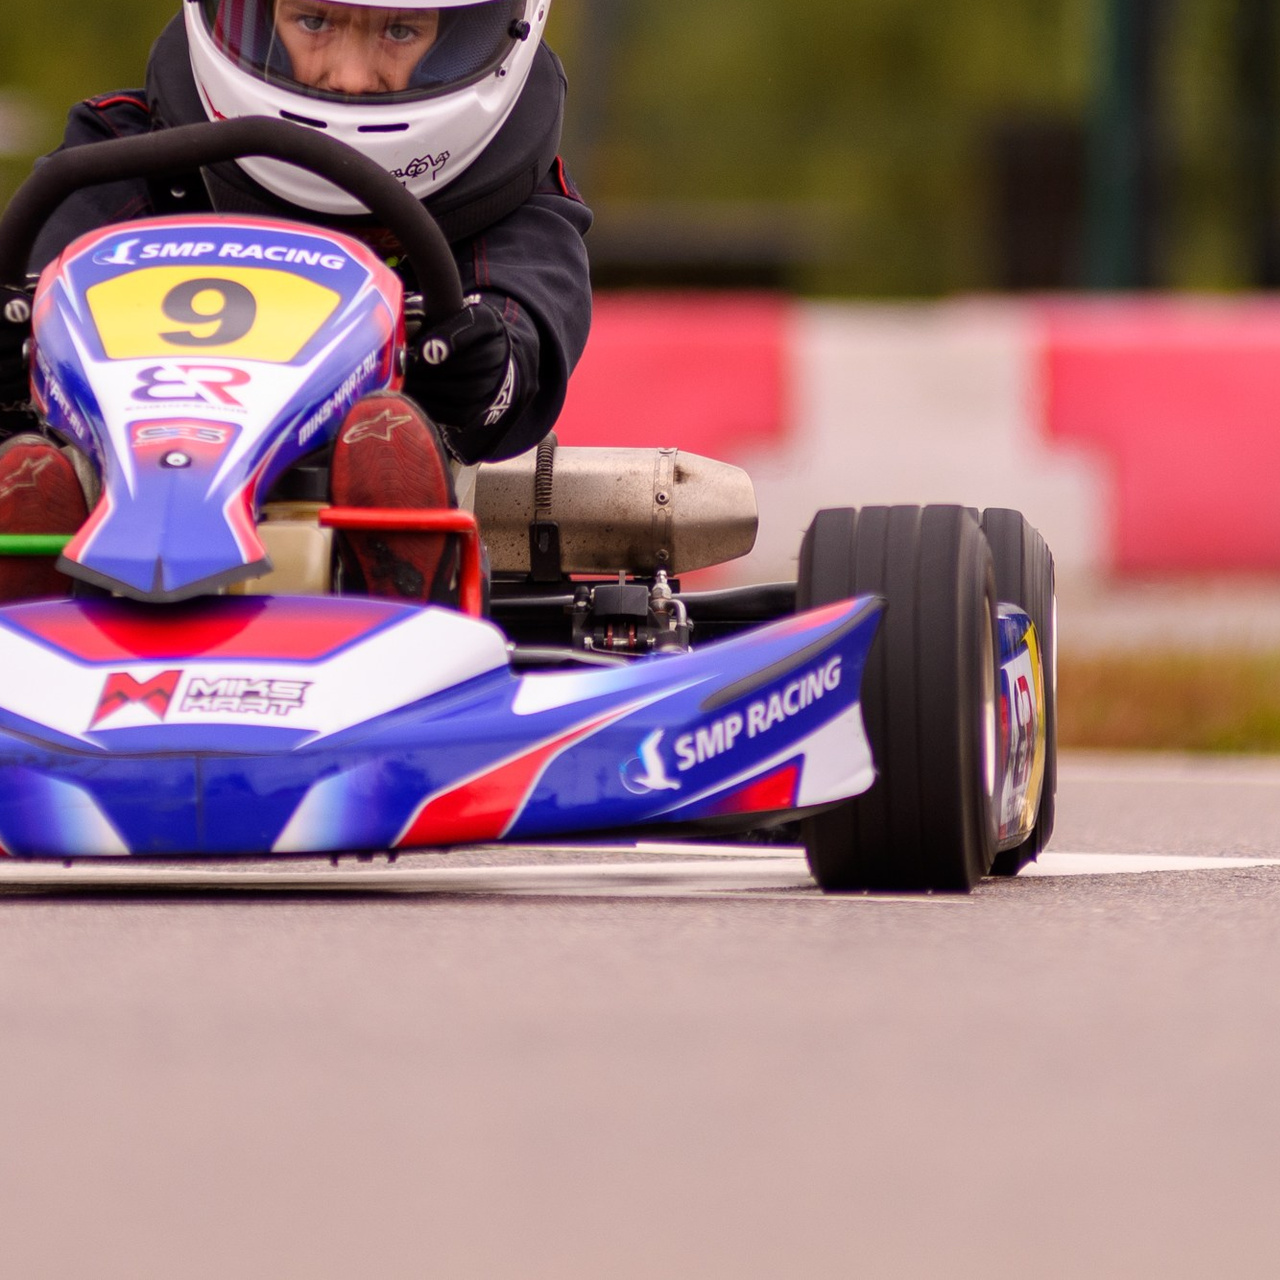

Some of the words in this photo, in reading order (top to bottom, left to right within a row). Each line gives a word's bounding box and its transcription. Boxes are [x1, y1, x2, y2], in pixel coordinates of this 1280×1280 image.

[139, 242, 214, 259] SMP
[218, 242, 347, 270] RACING
[158, 277, 258, 348] 9
[184, 677, 315, 700] MIKS
[179, 697, 303, 716] KART
[674, 712, 743, 771] SMP
[746, 655, 842, 739] RACING
